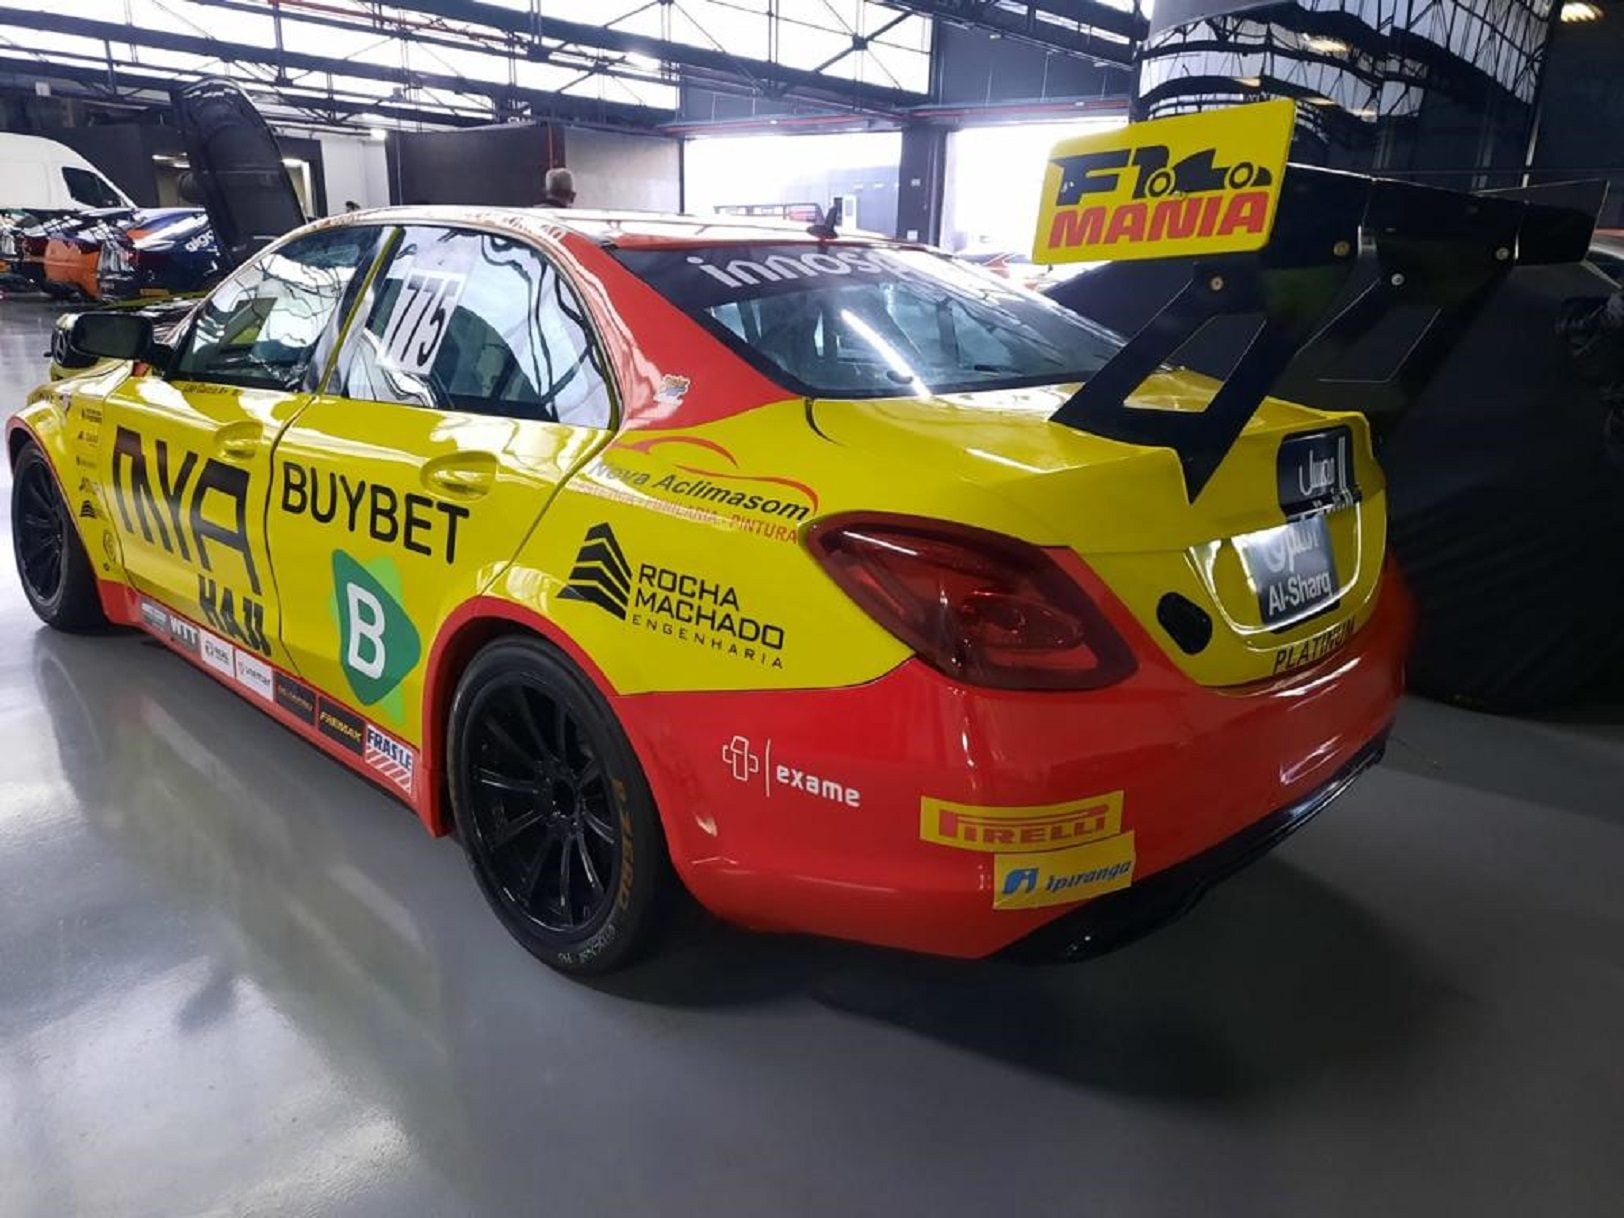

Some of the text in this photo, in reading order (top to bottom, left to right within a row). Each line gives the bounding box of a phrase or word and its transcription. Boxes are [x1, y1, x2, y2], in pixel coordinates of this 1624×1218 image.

[1051, 145, 1170, 206] F1
[1047, 191, 1270, 250] MANIA
[282, 461, 470, 565] BUYBET
[588, 460, 651, 486] Nova
[653, 473, 810, 521] Aclimasom
[731, 514, 798, 545] PINTURA
[638, 563, 740, 611] ROCHA
[1269, 572, 1334, 616] Al-Sharq
[346, 581, 386, 680] B
[632, 614, 784, 670] ENGENHARIA
[634, 588, 785, 650] MACHADO
[776, 764, 861, 808] exame
[938, 804, 1111, 844] PIRELLI
